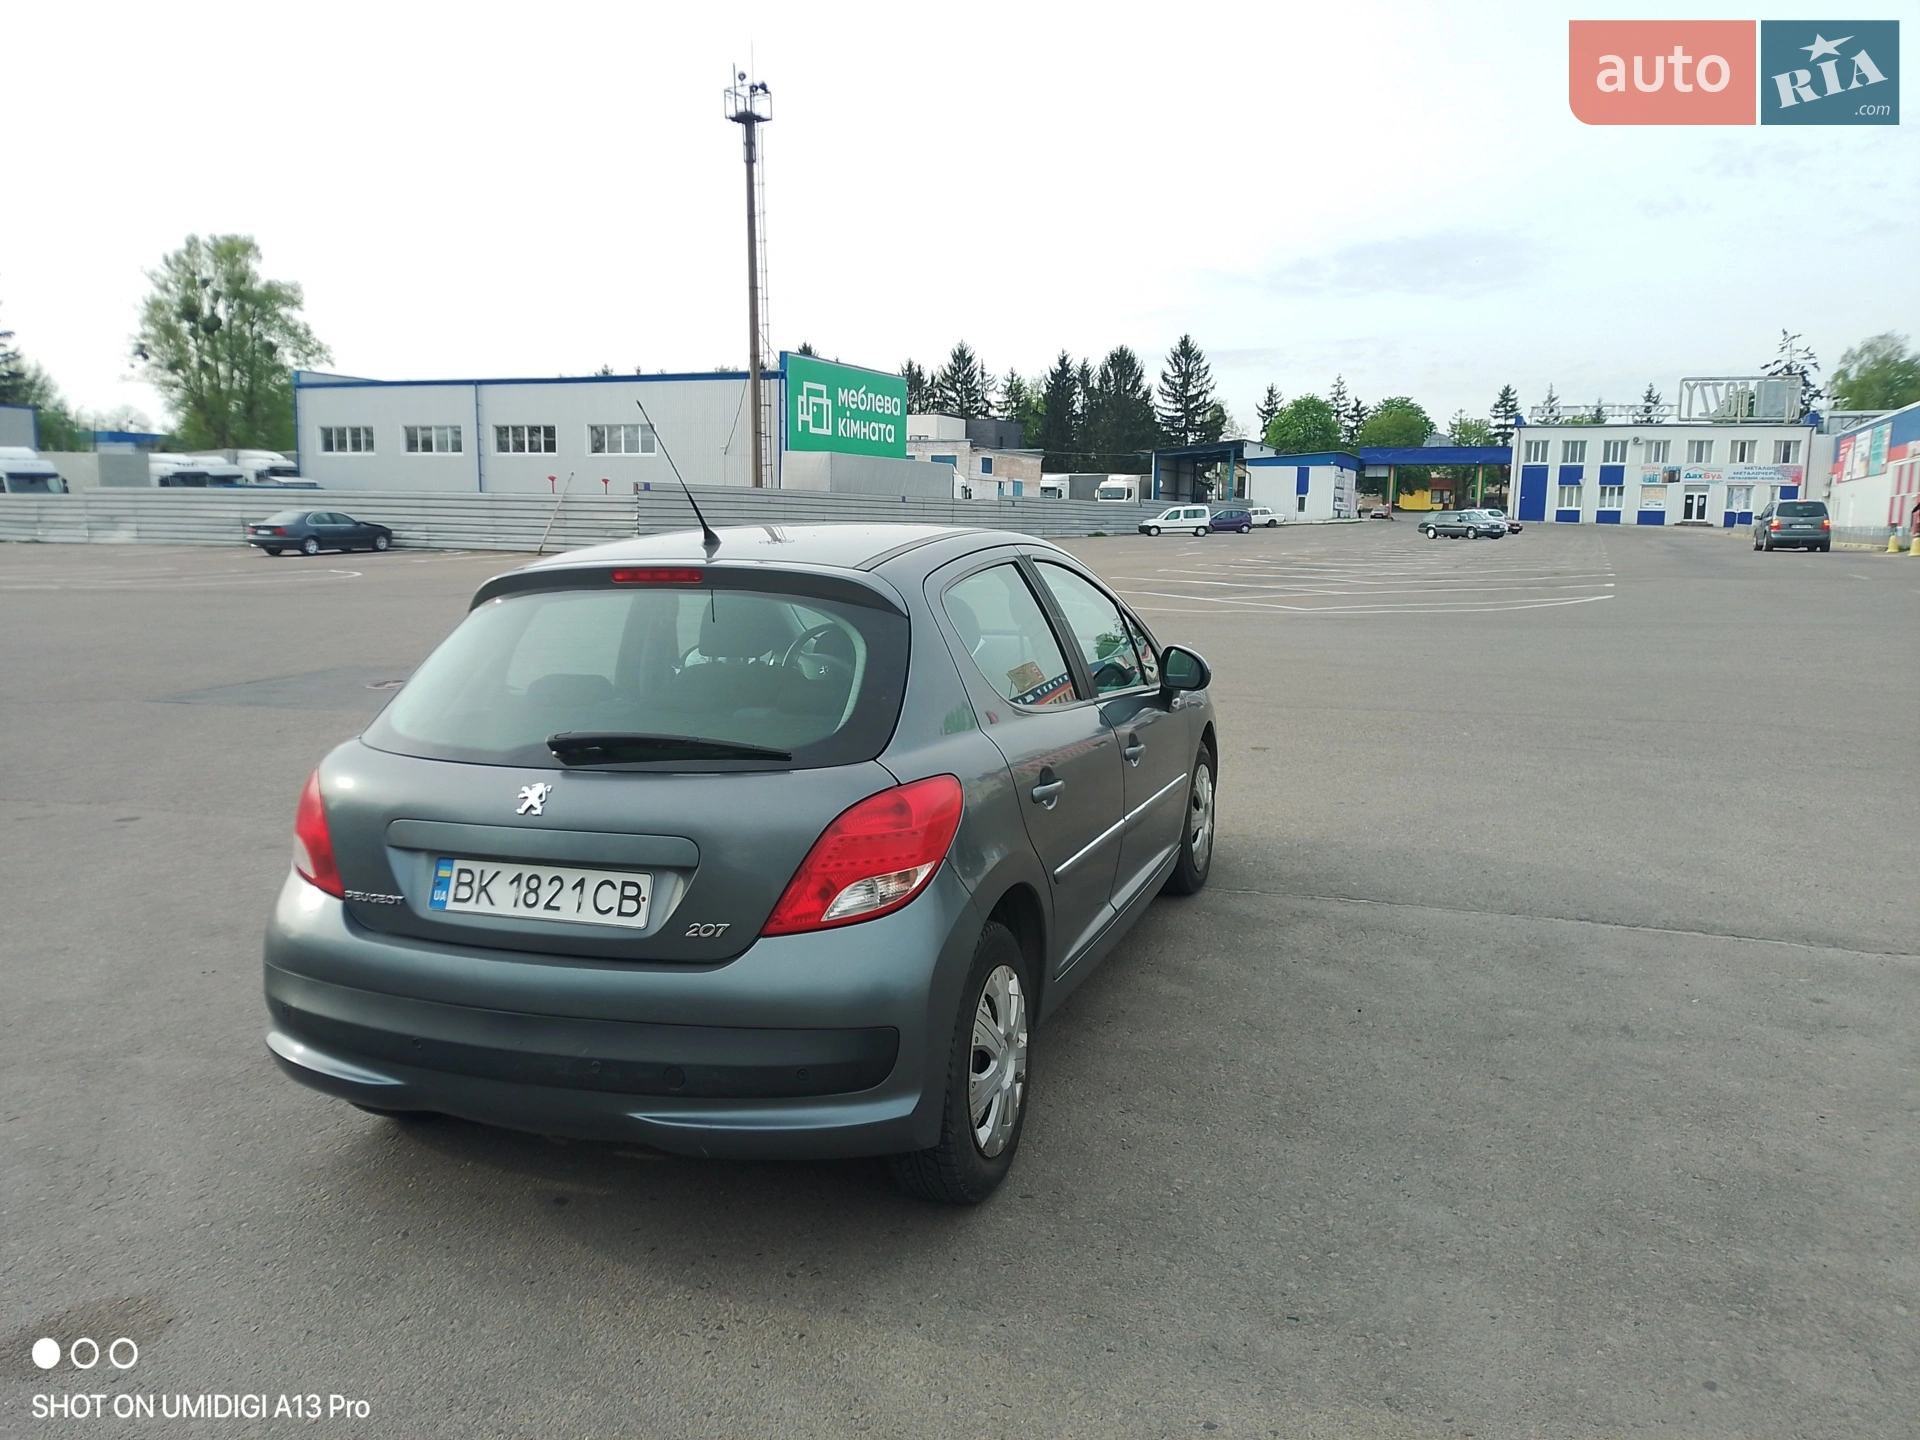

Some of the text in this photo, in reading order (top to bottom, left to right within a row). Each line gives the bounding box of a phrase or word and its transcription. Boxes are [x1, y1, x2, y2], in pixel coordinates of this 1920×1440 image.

[838, 384, 901, 416] меблева
[838, 410, 895, 443] кімната
[344, 889, 405, 905] PEUGEOT
[685, 922, 731, 938] 207
